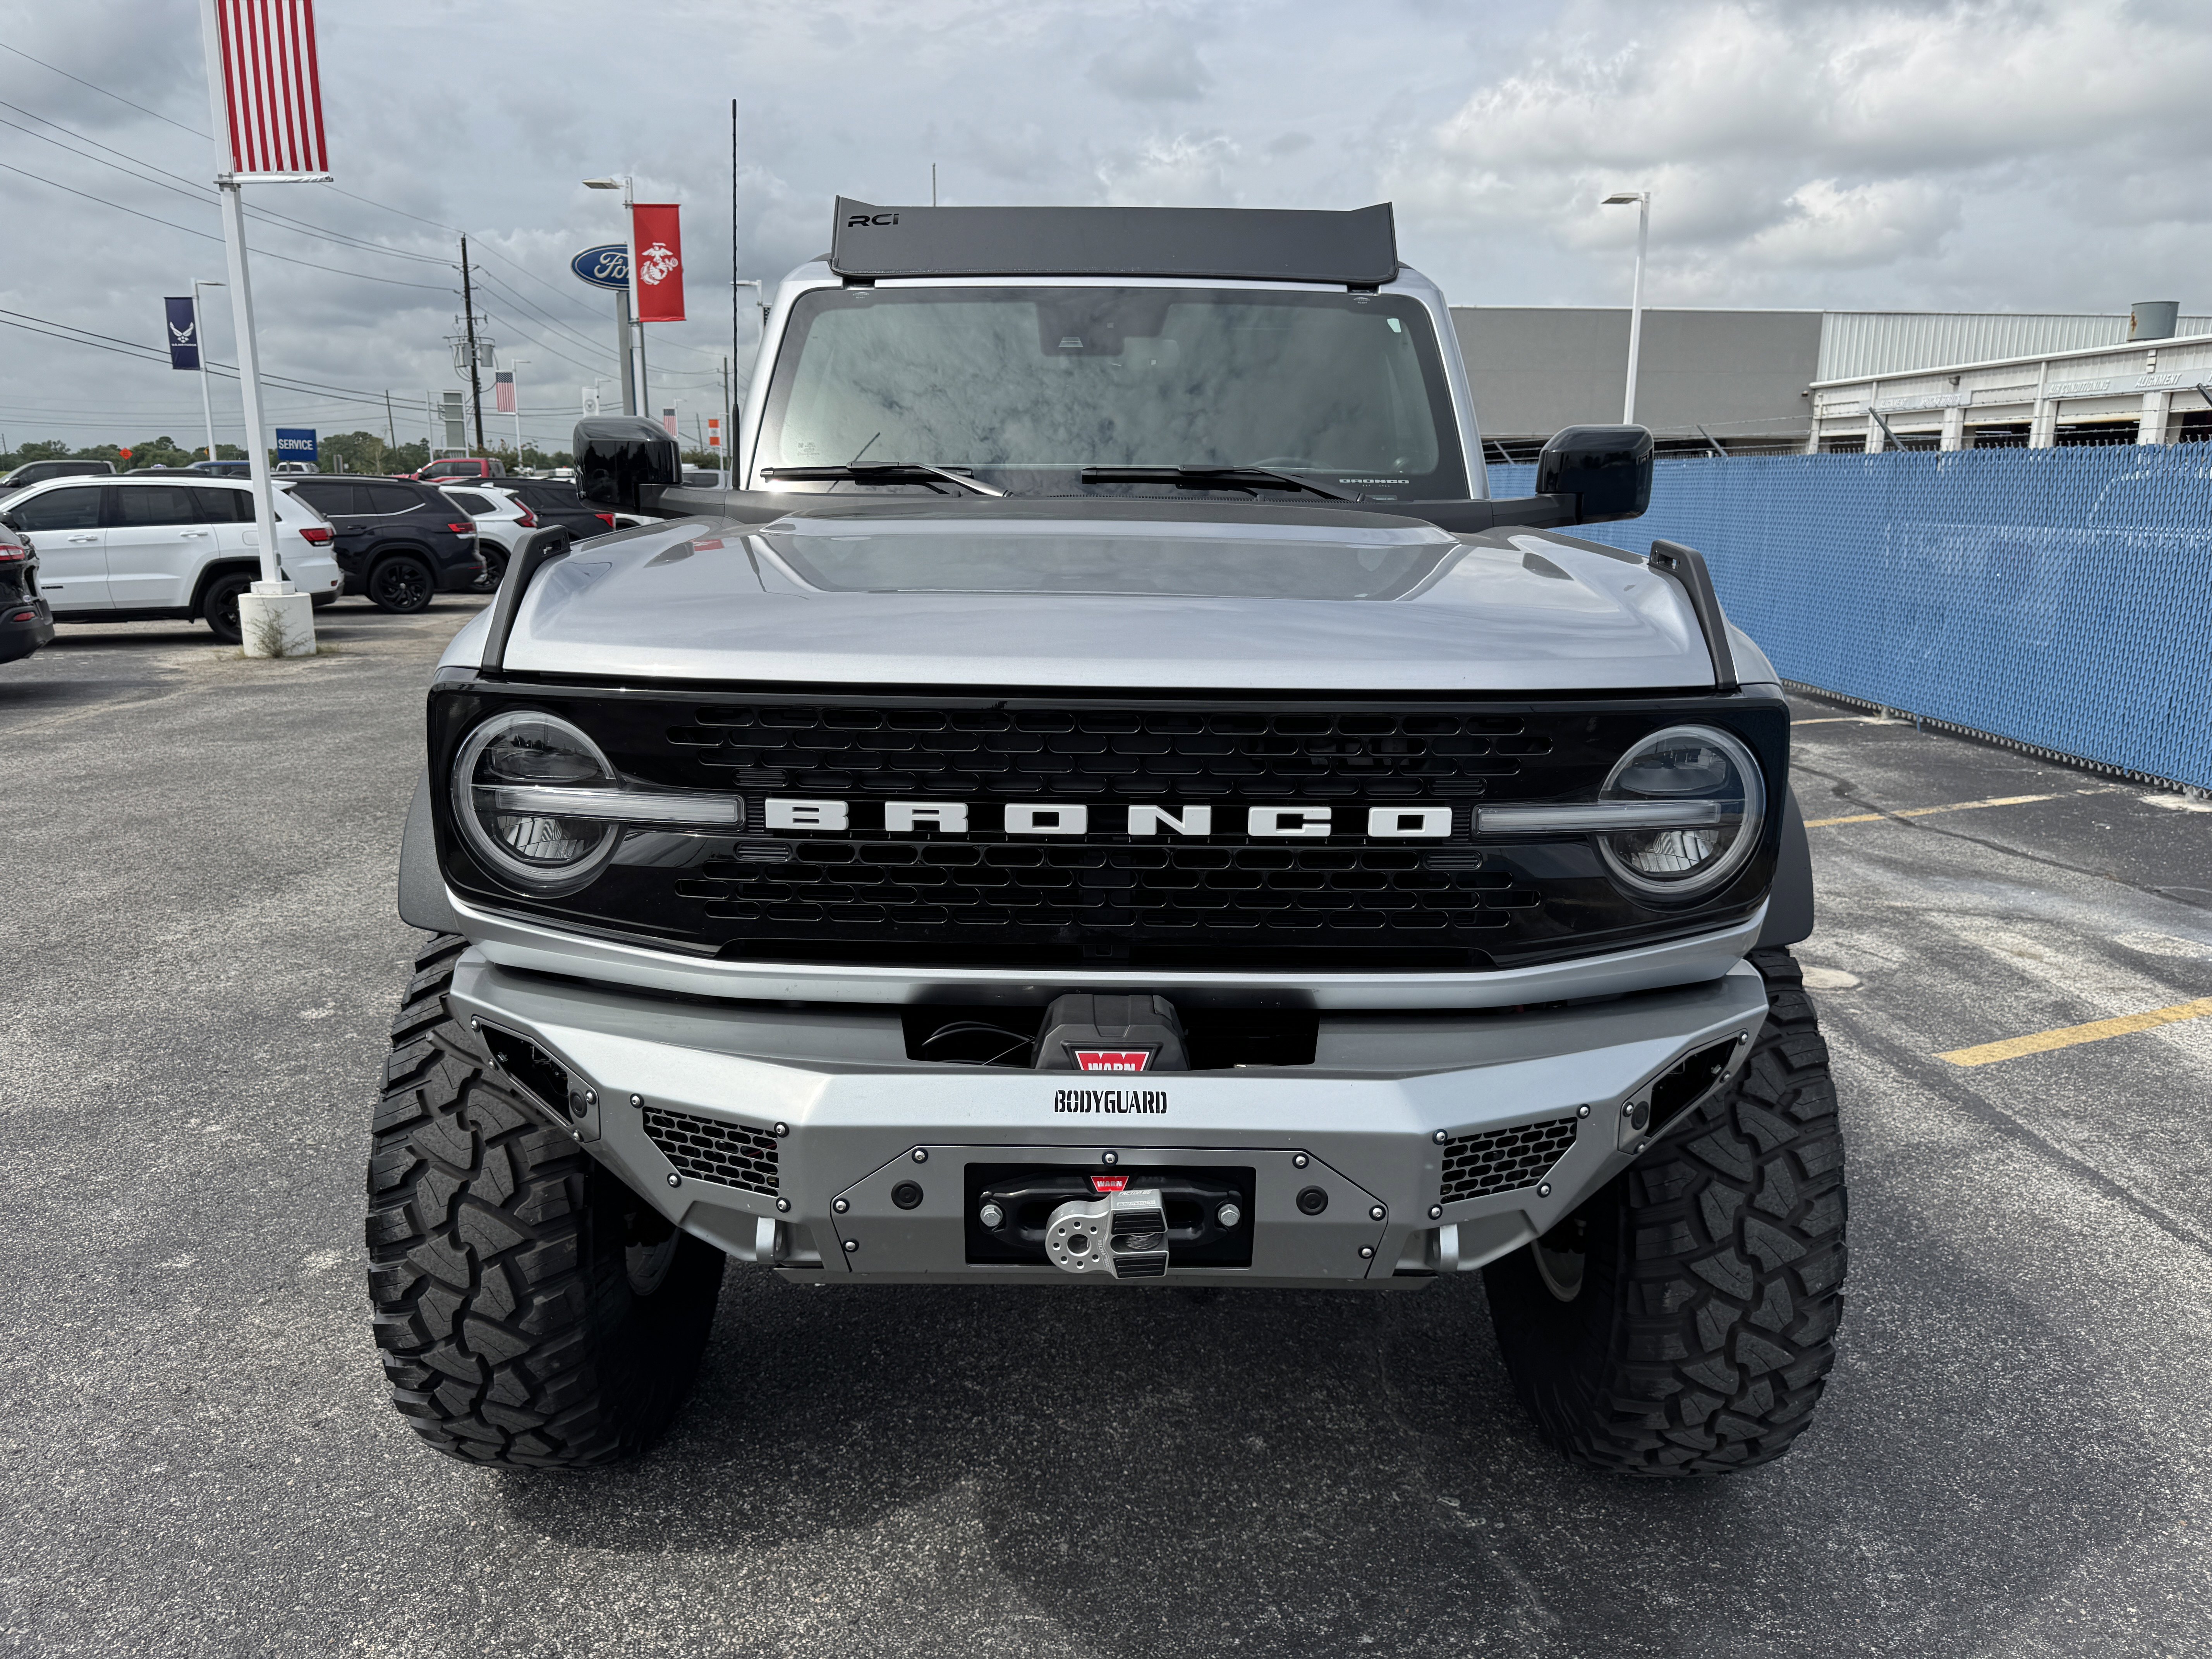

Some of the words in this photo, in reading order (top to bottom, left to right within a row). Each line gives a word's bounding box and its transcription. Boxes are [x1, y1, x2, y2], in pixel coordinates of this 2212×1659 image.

[848, 213, 899, 227] RCI
[594, 252, 630, 278] Fo
[2048, 384, 2061, 394] AIR
[2061, 380, 2110, 394] CONDITIONING
[2135, 373, 2182, 388] ALIGNMENT
[278, 439, 314, 450] SERVICE
[765, 798, 1452, 837] BRONCO
[1054, 1090, 1167, 1113] BODYGUARD
